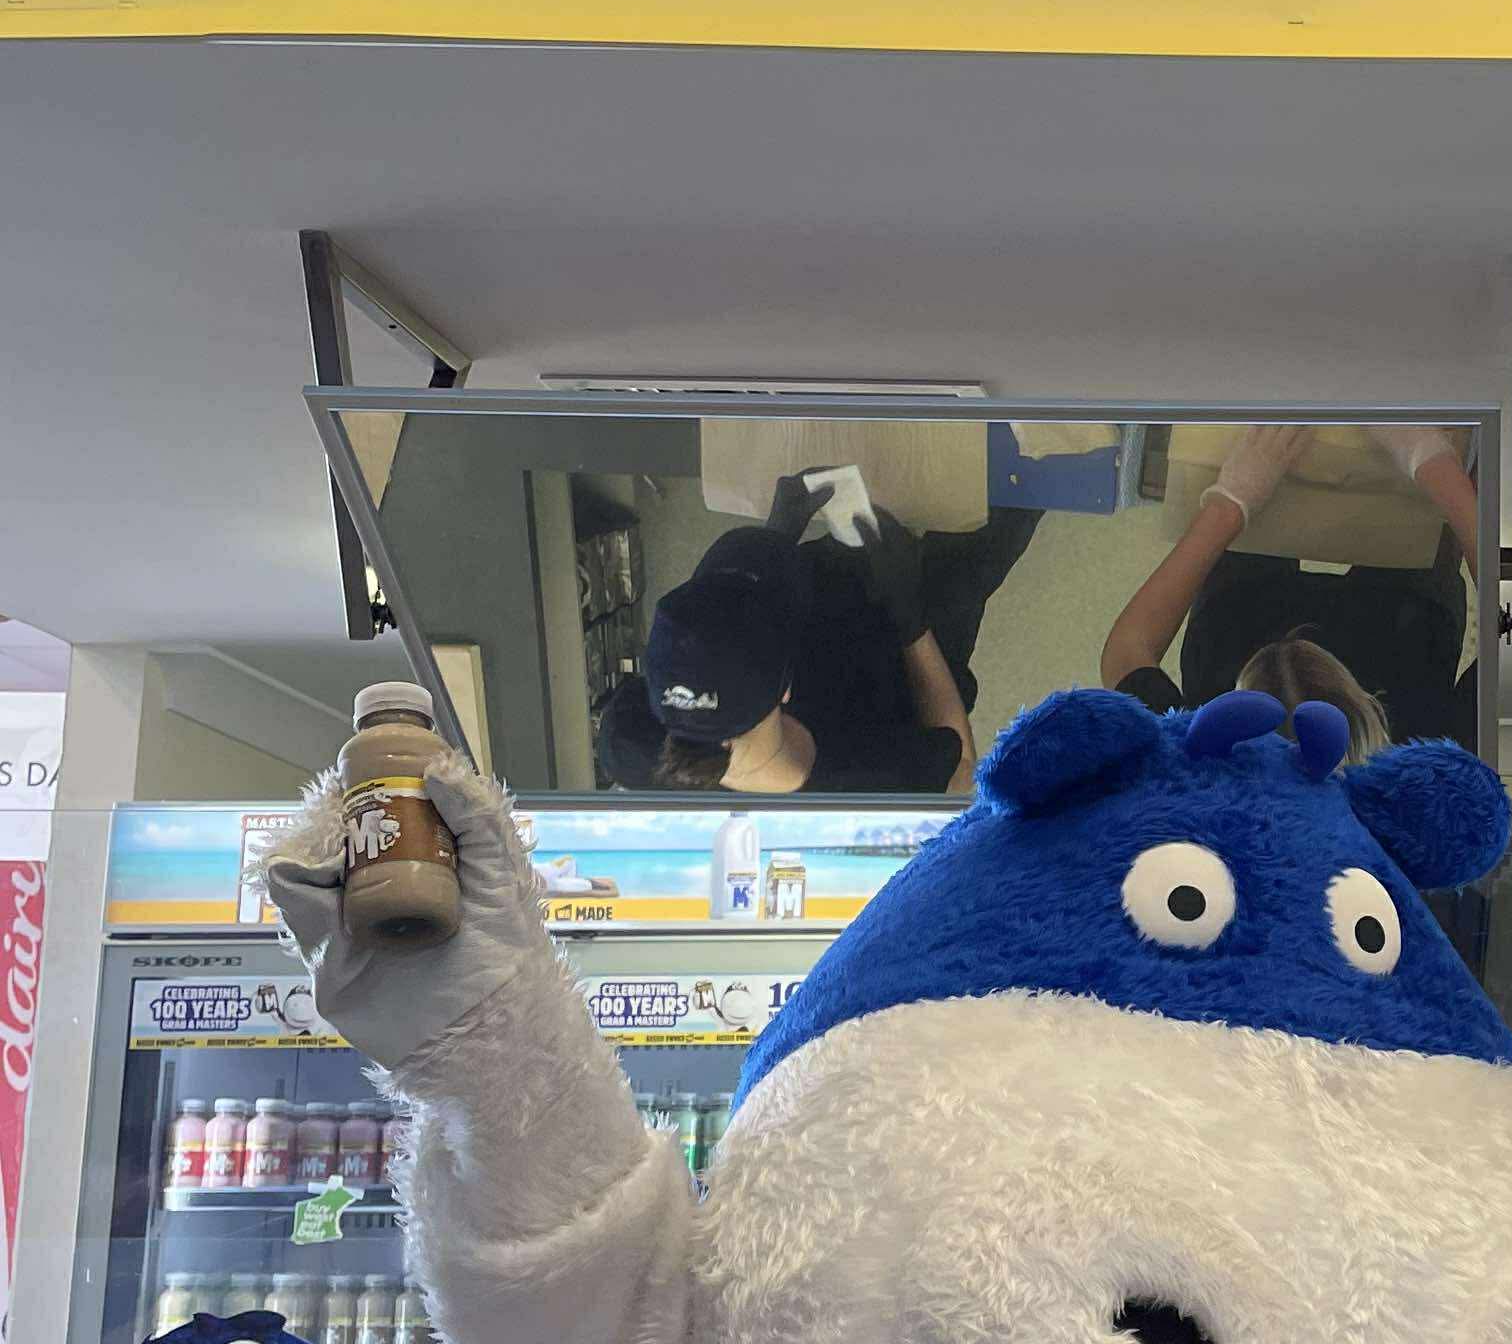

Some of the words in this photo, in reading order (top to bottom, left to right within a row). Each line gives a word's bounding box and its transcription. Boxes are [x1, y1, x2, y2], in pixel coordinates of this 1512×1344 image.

[776, 882, 803, 918] M
[575, 905, 613, 921] MADE
[131, 955, 243, 968] SKOPE
[164, 987, 239, 1000] CELEBRATING
[601, 983, 677, 996] CELEBRATING
[152, 1000, 188, 1019] 100
[193, 1001, 249, 1019] YEARS
[590, 996, 627, 1015] 100
[631, 997, 688, 1016] YEARS
[161, 1020, 186, 1030] GRAB
[188, 1020, 196, 1030] A
[197, 1020, 237, 1031] MASTERS
[601, 1016, 625, 1026] GRAB
[626, 1016, 634, 1026] A
[635, 1016, 674, 1026] MASTERS
